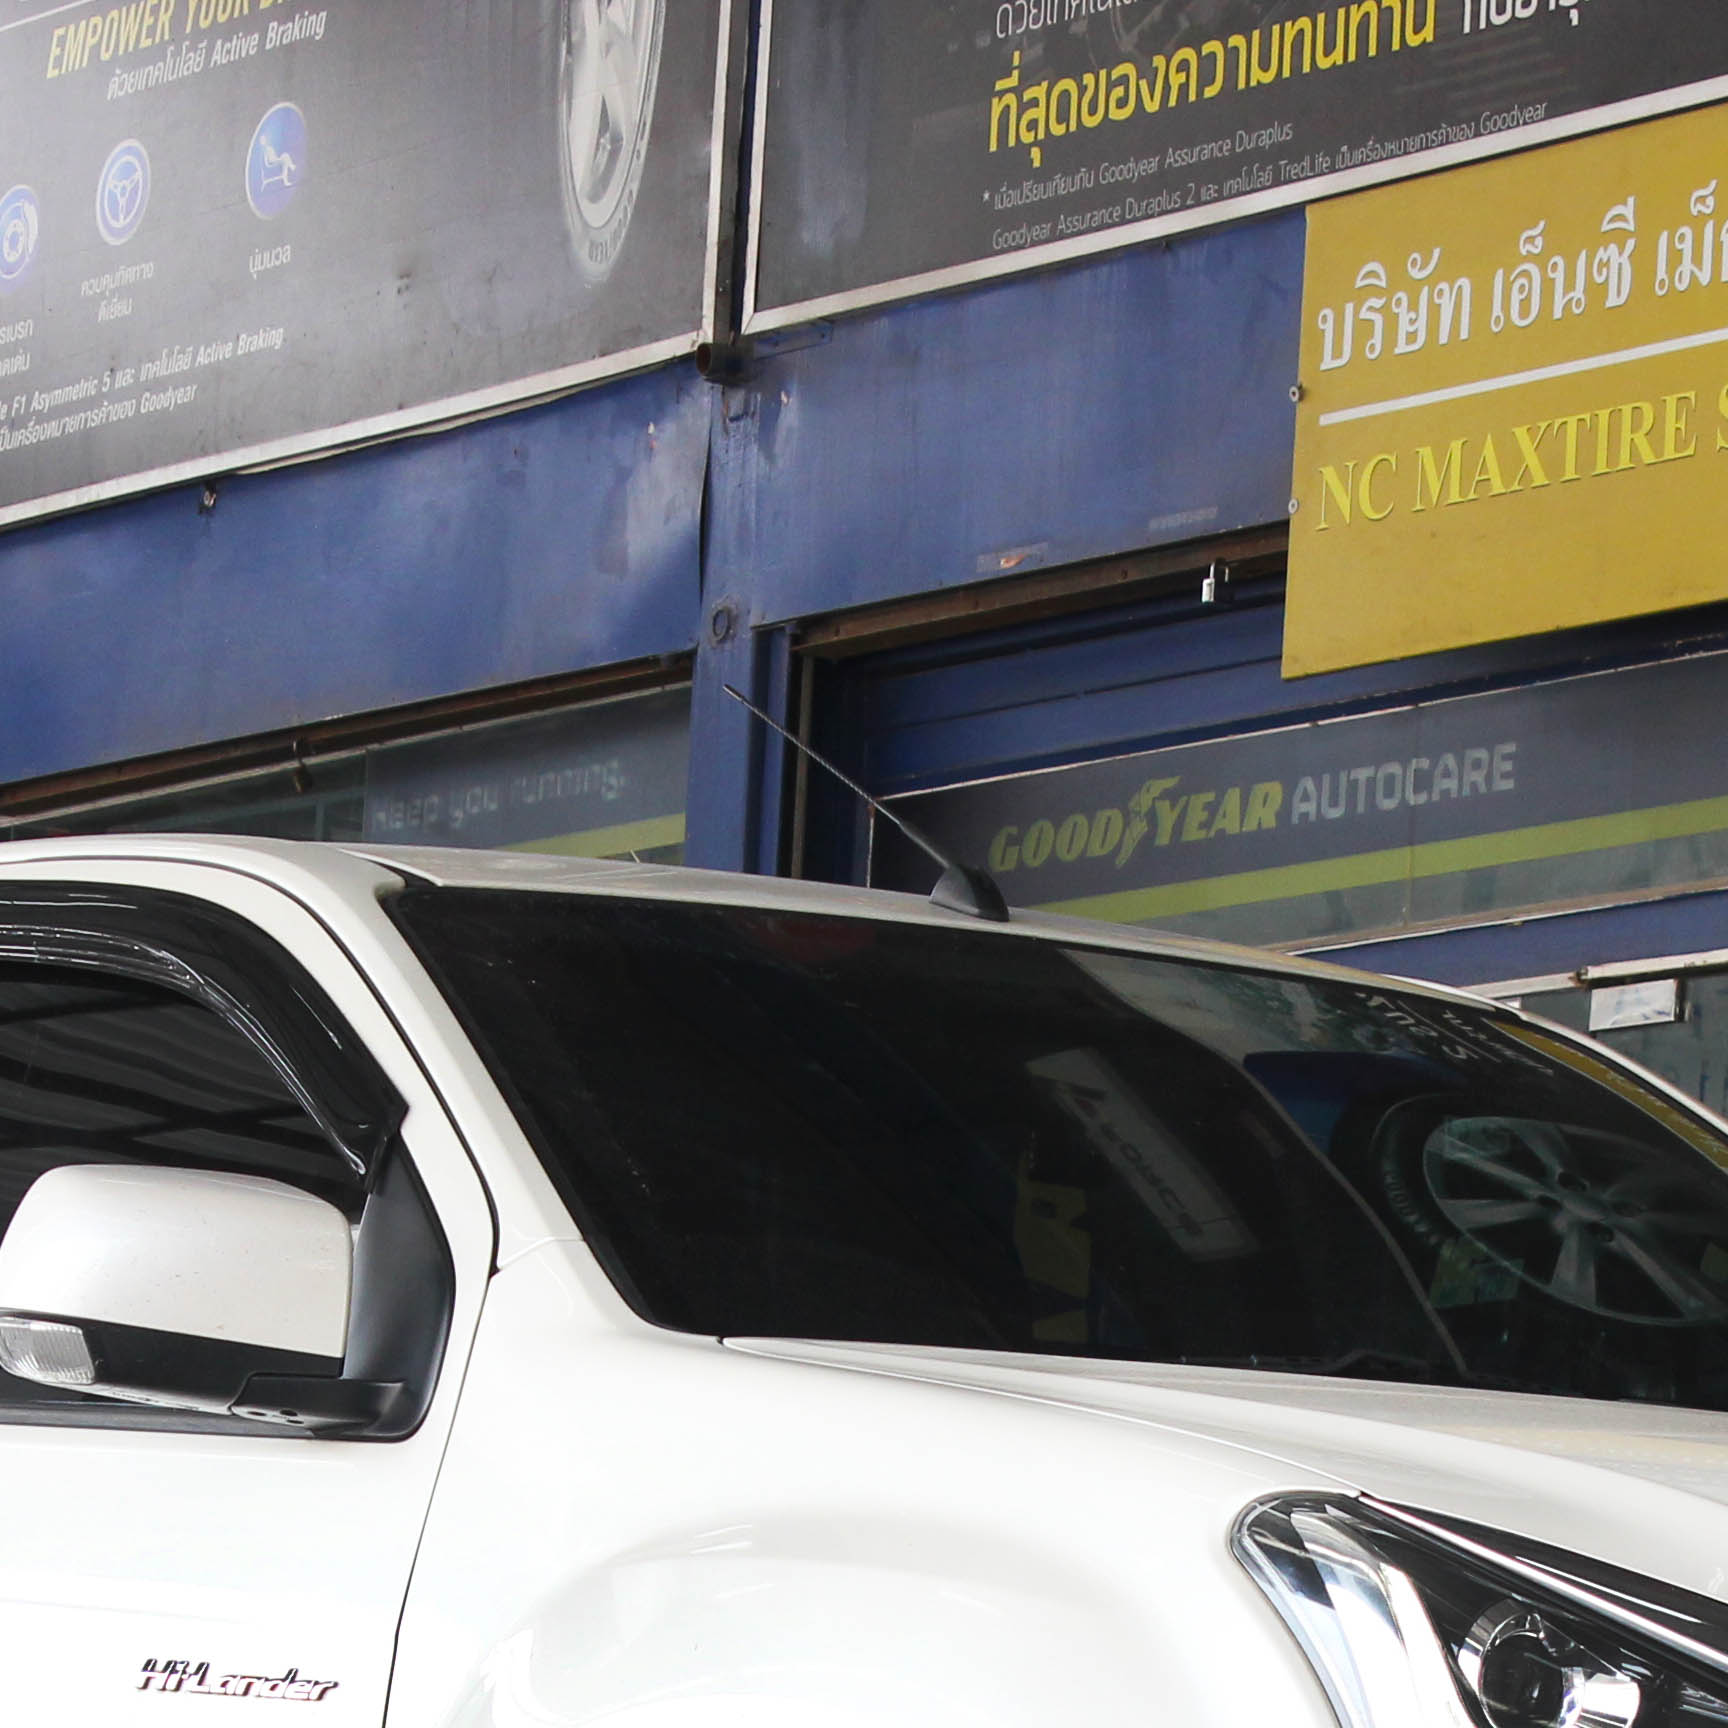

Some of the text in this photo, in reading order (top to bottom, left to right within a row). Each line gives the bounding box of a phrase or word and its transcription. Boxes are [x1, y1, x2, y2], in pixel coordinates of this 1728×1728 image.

[46, 0, 174, 80] EMPOWER
[210, 33, 259, 69] Active
[265, 10, 327, 50] Braking
[992, 219, 1051, 250] Goodyear
[1057, 206, 1121, 236] Assurance
[1125, 186, 1181, 219] Duraplus
[1186, 184, 1195, 203] 2
[1279, 153, 1331, 182] TredLife
[1480, 102, 1548, 136] Goodyear
[1099, 154, 1160, 184] Goodyear
[1164, 137, 1231, 168] Assurance
[1235, 120, 1294, 153] Duraplus
[1318, 246, 1472, 371] บริษัท
[1490, 196, 1636, 334] เอ็นซี
[12, 394, 27, 418] F1
[30, 379, 99, 414] Asymmetric
[102, 373, 111, 393] 5
[195, 340, 233, 369] Active
[237, 326, 284, 357] Braking
[140, 382, 198, 416] Goodyear
[1315, 453, 1399, 532] NC
[1412, 389, 1697, 513] MAXTIRE
[989, 742, 1516, 868] GOODYEAR AUTOCARE
